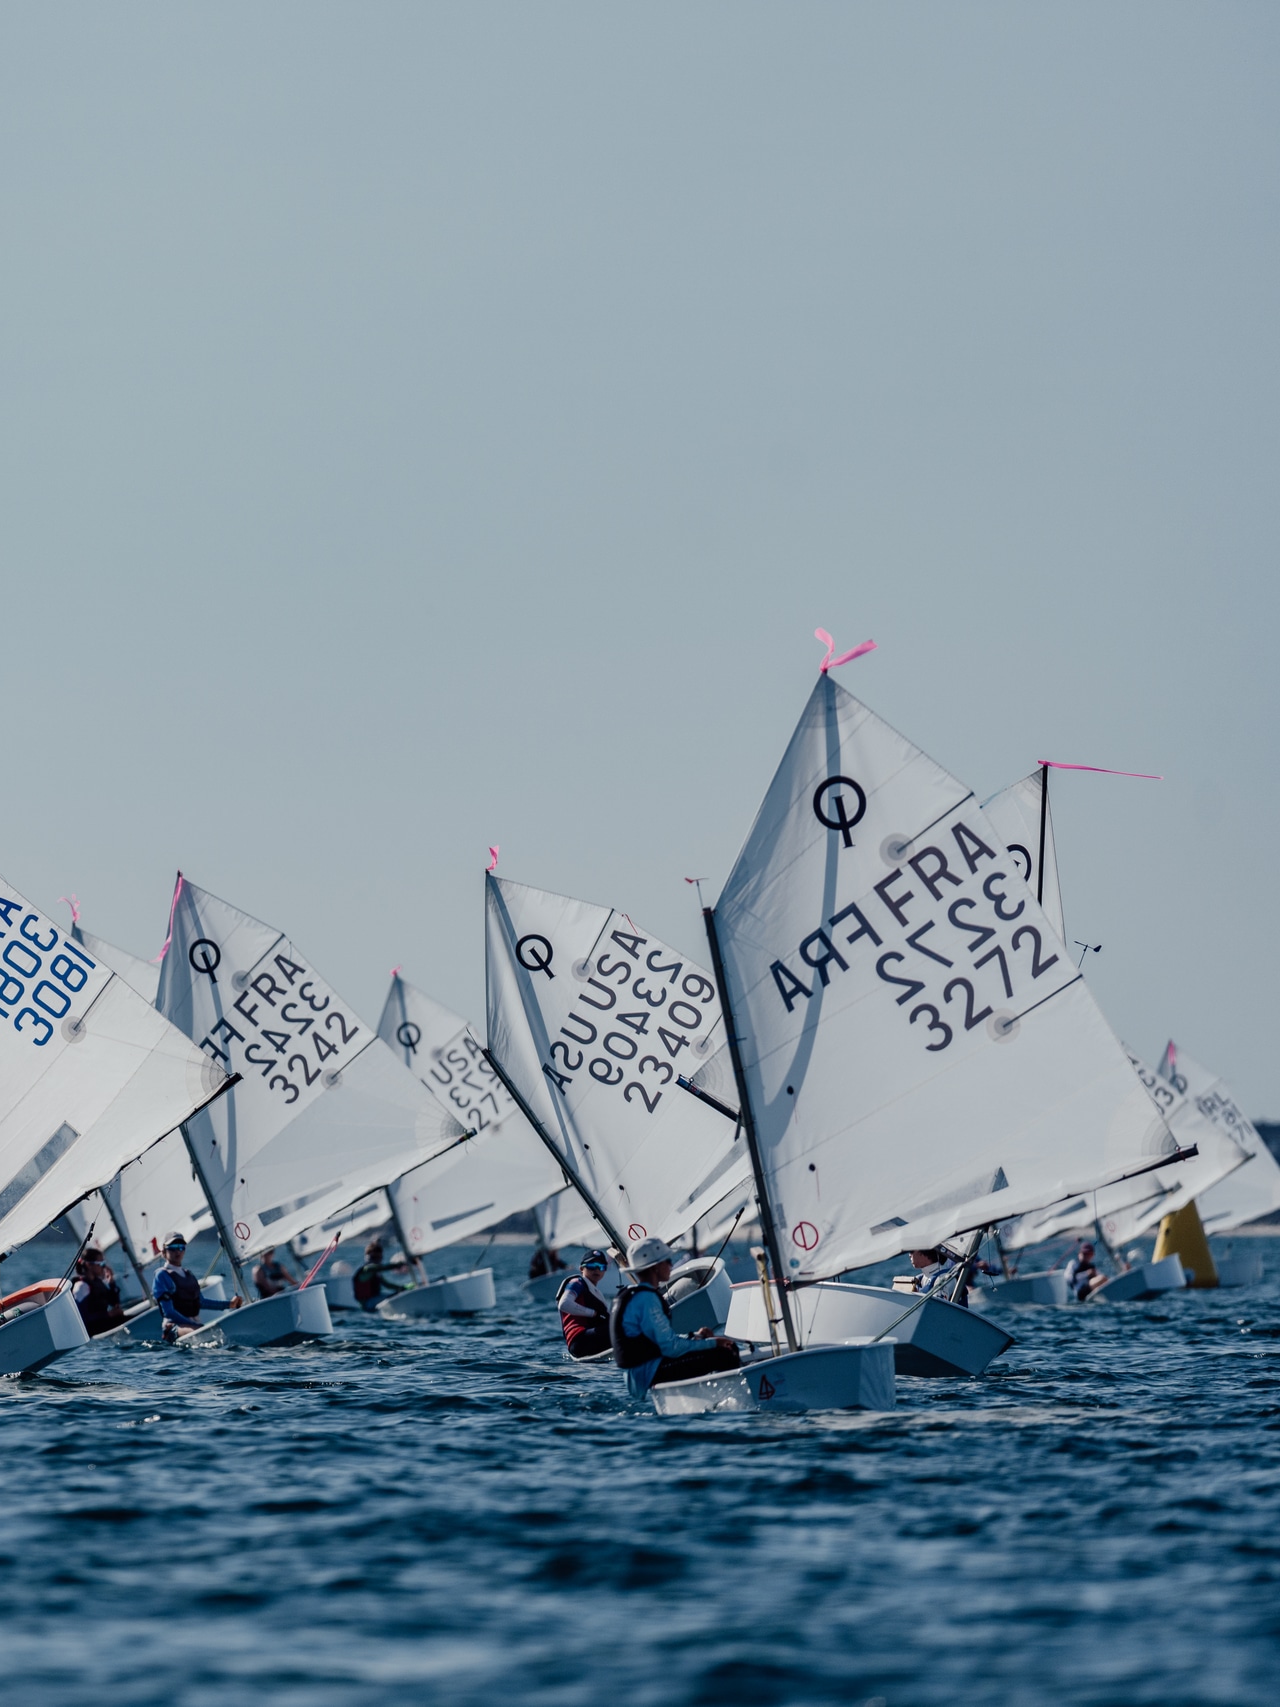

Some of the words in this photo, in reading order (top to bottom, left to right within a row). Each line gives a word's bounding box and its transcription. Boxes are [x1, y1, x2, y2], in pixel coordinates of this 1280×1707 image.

[873, 821, 997, 928] FRA
[14, 941, 96, 1046] 3081
[233, 954, 306, 1027] FRA
[578, 929, 648, 1011] USA
[909, 924, 1060, 1051] 3272
[269, 1011, 359, 1104] 3242
[430, 1036, 480, 1084] USA
[623, 973, 715, 1114] 23409
